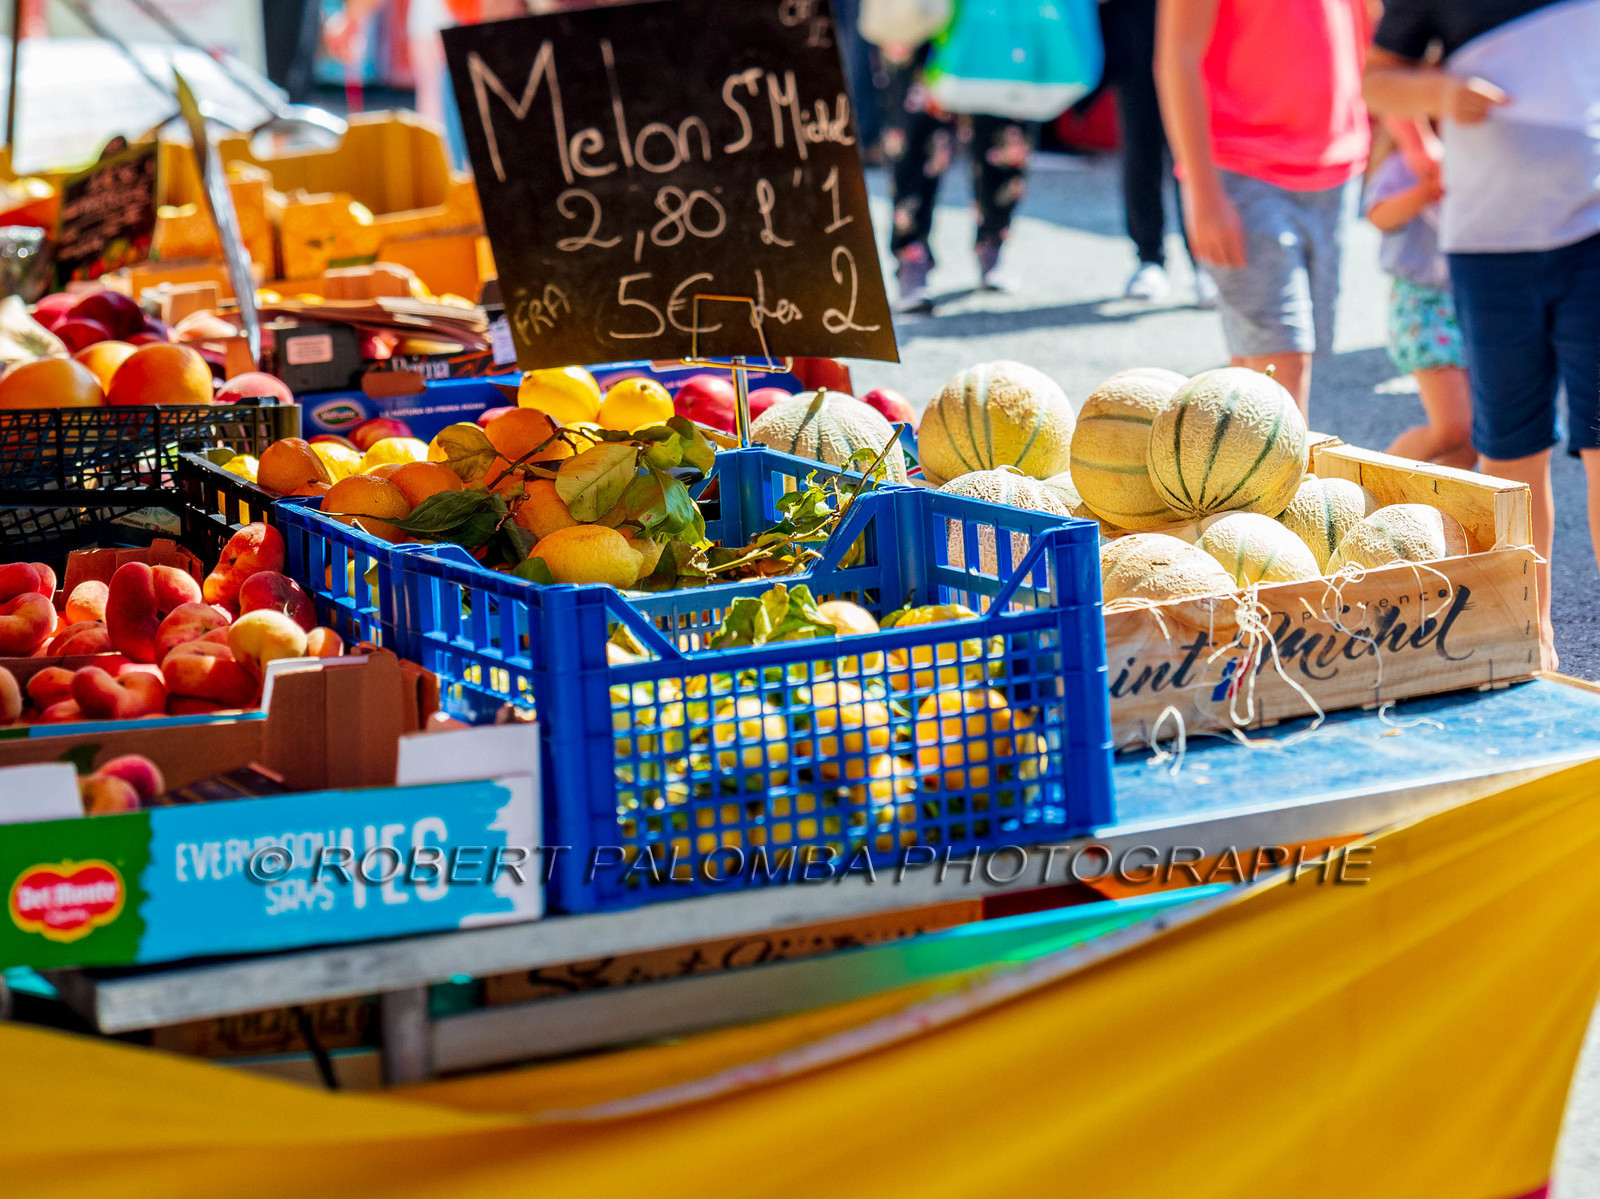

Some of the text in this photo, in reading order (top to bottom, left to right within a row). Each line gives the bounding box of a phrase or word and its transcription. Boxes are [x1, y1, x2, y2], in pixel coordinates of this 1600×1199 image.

[468, 39, 712, 184] Melon
[555, 185, 727, 263] 2,80
[609, 273, 722, 338] 5€
[822, 246, 881, 334] 2
[1233, 584, 1475, 680] Michel
